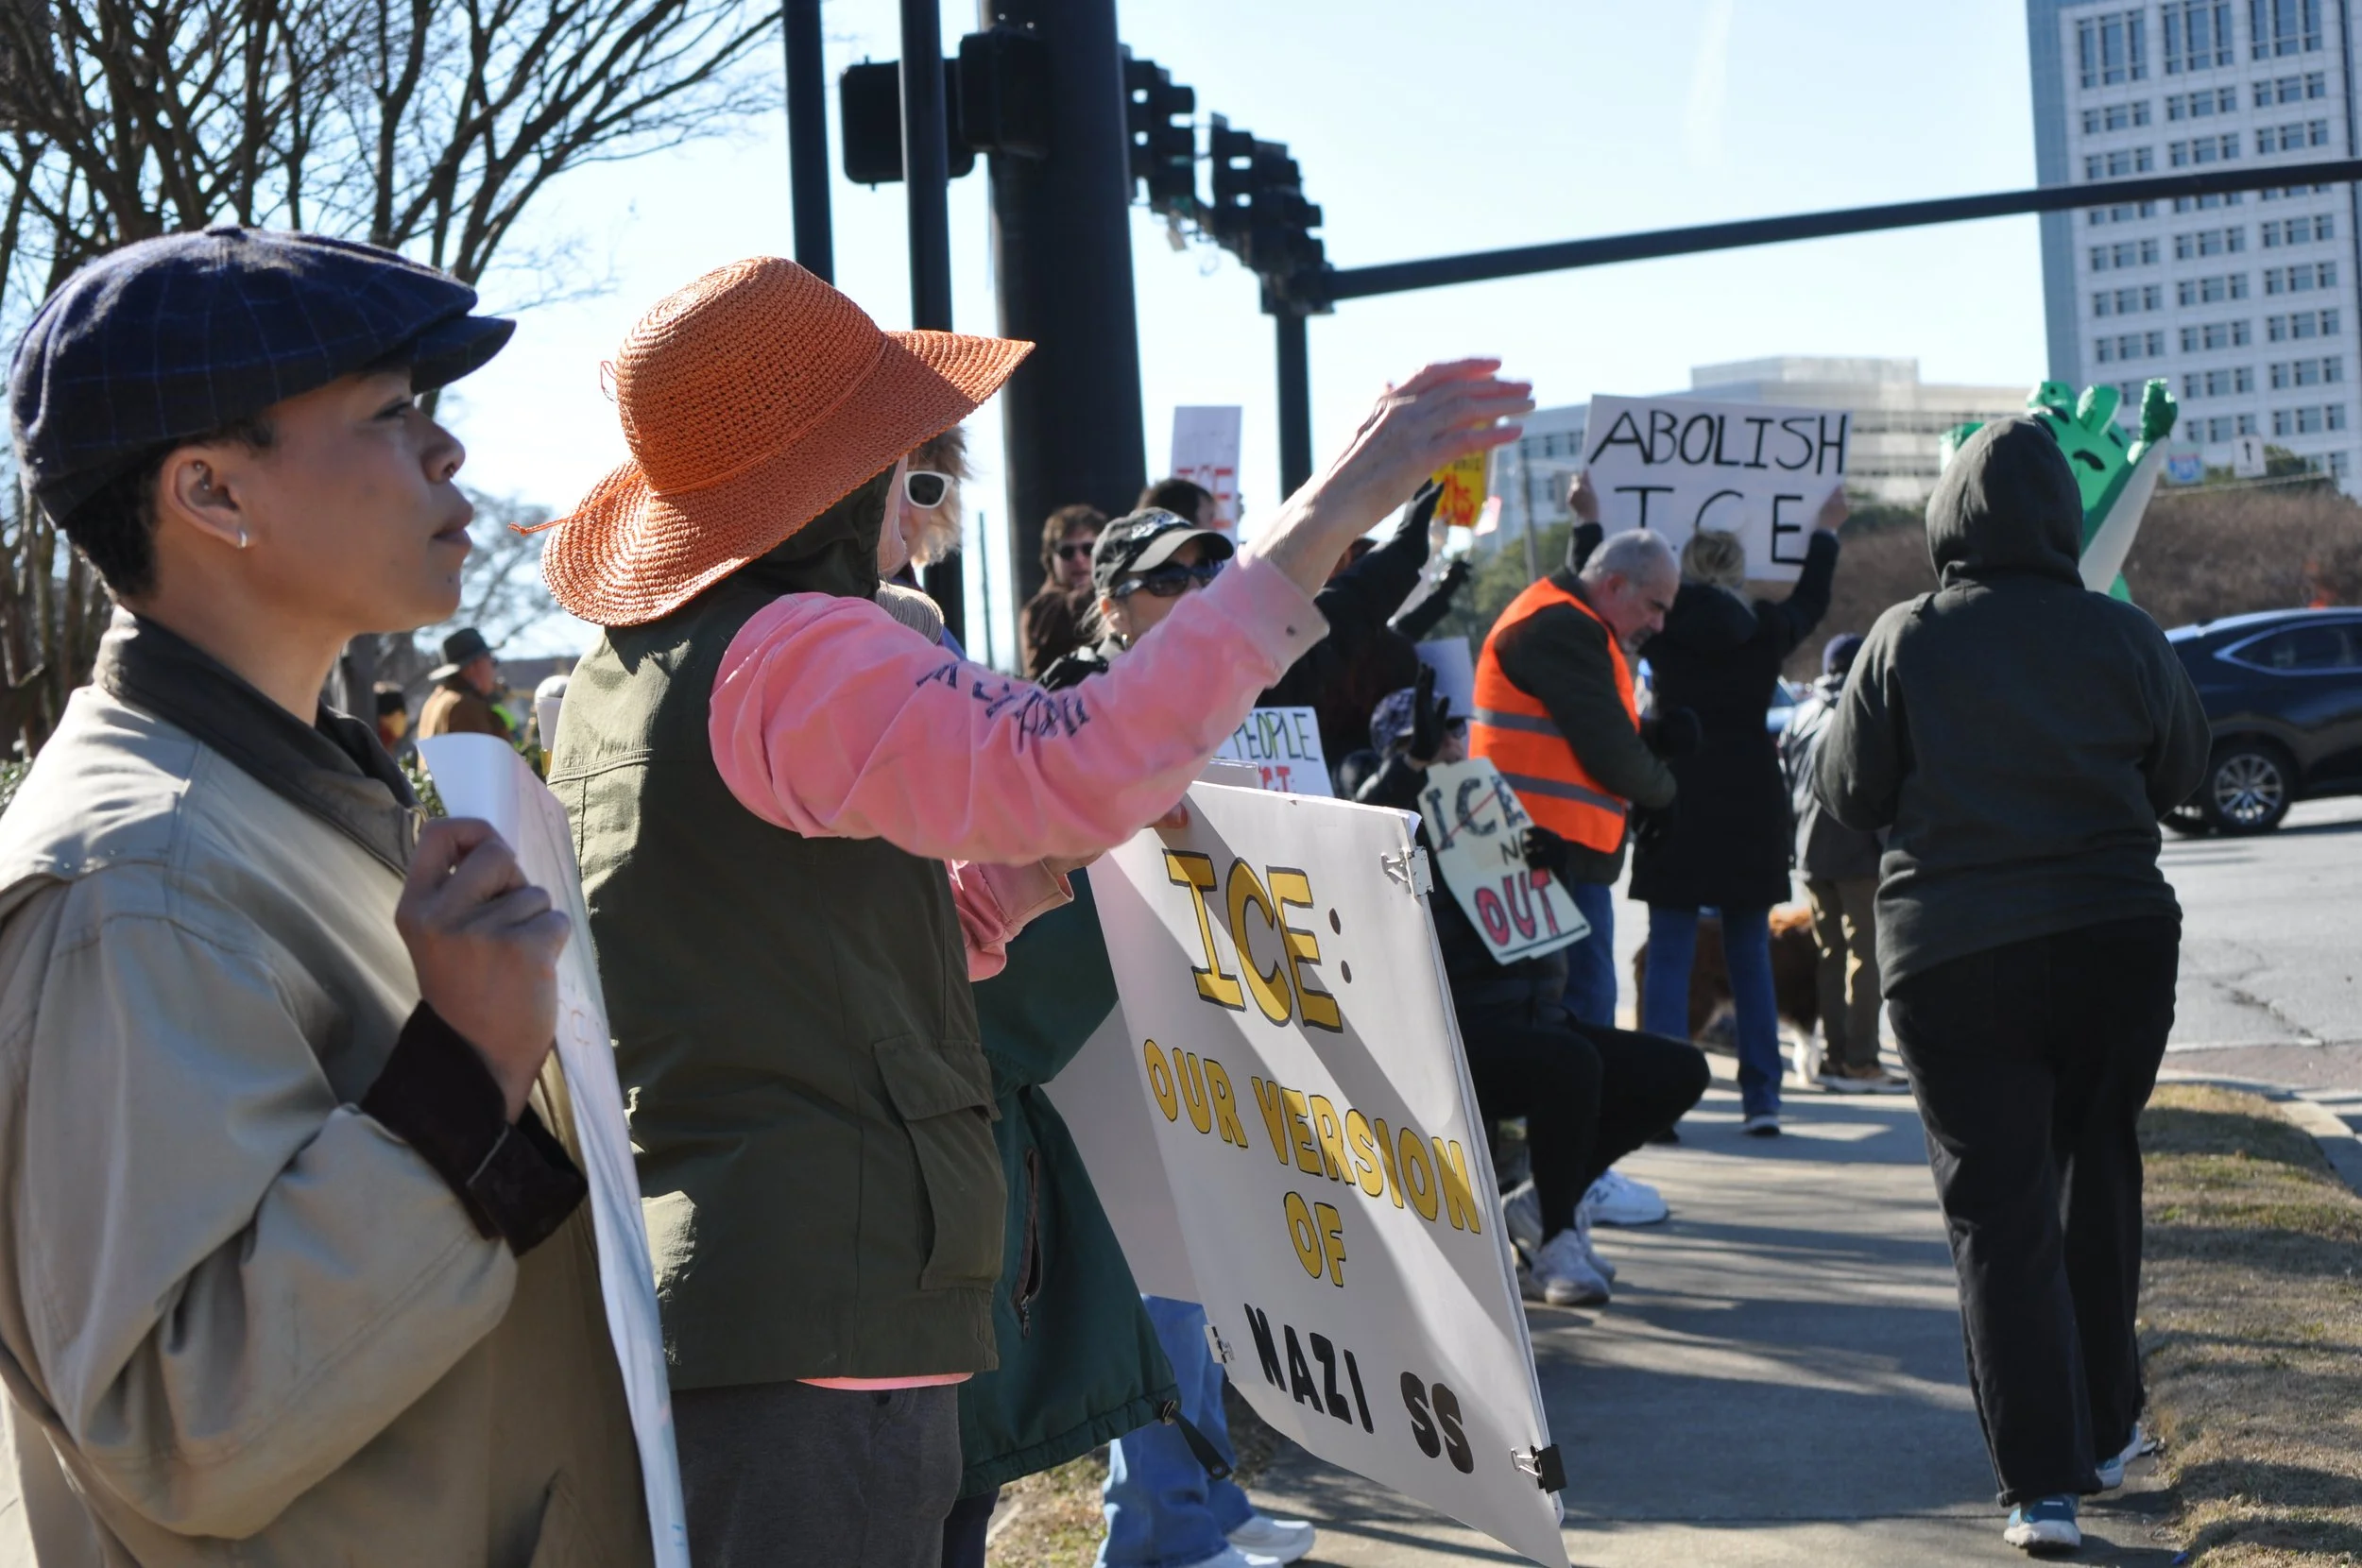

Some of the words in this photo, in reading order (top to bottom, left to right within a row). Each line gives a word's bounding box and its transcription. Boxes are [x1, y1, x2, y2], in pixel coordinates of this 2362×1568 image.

[1589, 410, 1847, 474] ABOLISH
[1162, 848, 1352, 1032] ICE:
[1475, 868, 1561, 946] OUT
[1144, 1039, 1248, 1149] OUR
[1252, 1076, 1481, 1235] VERSION
[1284, 1191, 1346, 1287] OF
[1243, 1303, 1374, 1434] NAZI
[1400, 1371, 1474, 1474] SS
